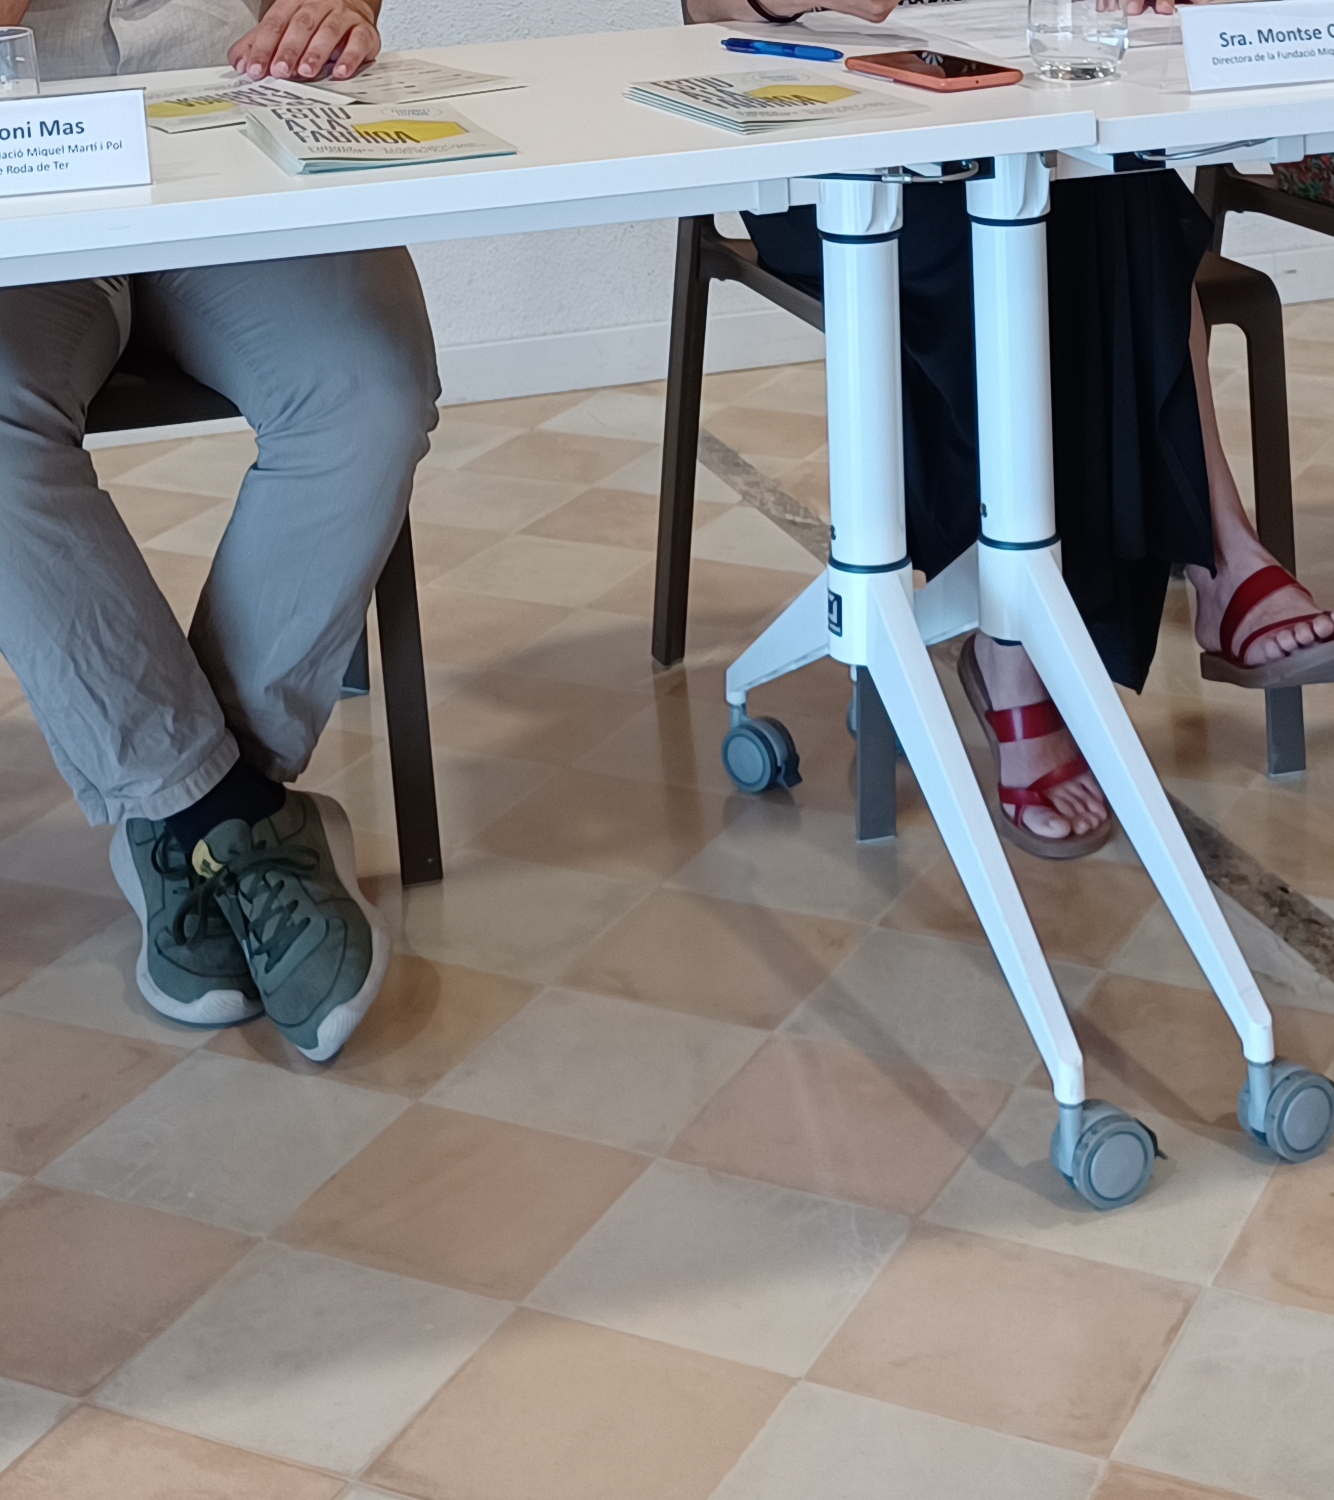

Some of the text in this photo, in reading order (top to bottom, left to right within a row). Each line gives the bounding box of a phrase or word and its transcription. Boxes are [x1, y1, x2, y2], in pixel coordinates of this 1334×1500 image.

[1219, 31, 1253, 48] Sra.
[1257, 26, 1322, 45] Montse
[1212, 54, 1253, 66] Directora
[1254, 53, 1266, 62] de
[1267, 51, 1275, 61] la
[1277, 48, 1316, 60] Fundació
[39, 120, 85, 137] Mas
[27, 146, 65, 160] Miquel
[68, 142, 98, 154] Martí
[100, 141, 104, 151] i
[106, 140, 123, 150] Pol
[7, 164, 34, 175] Roda
[36, 162, 50, 173] de
[53, 161, 69, 171] Ter
